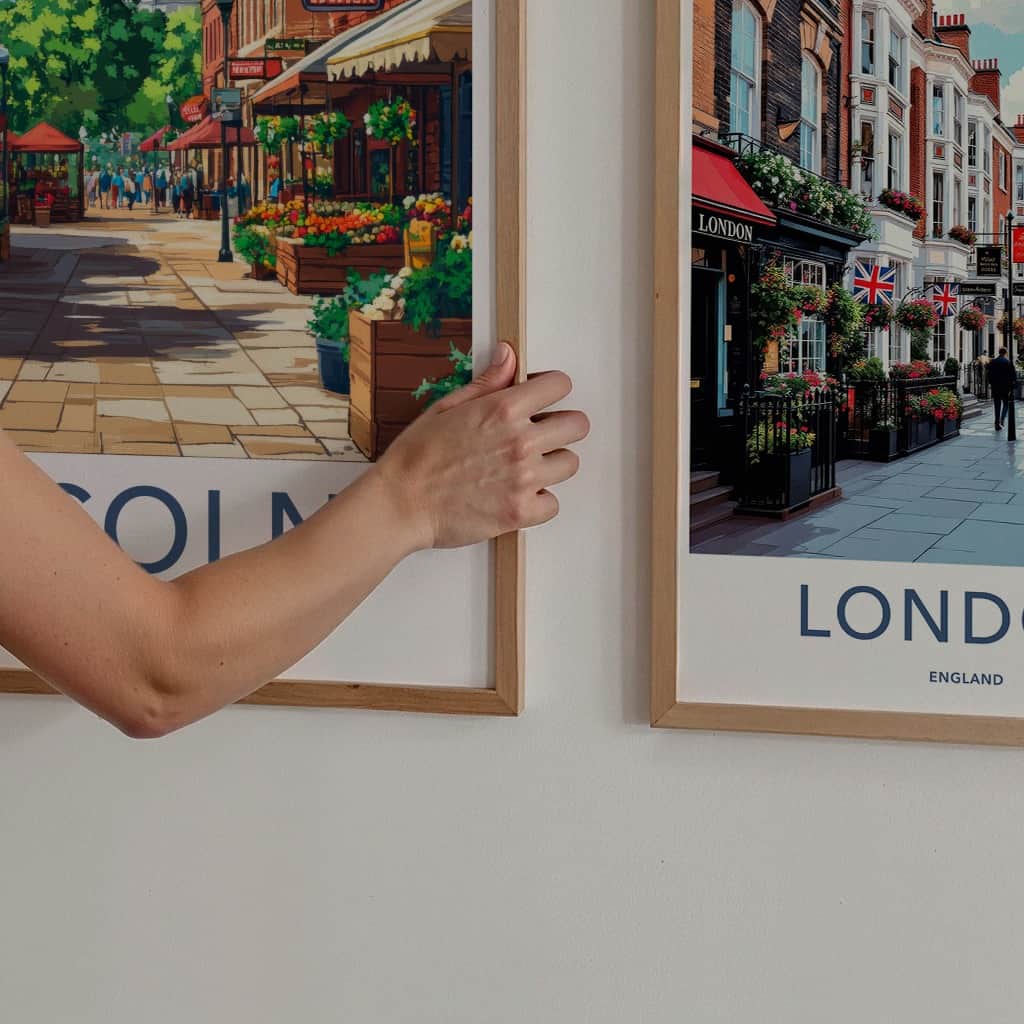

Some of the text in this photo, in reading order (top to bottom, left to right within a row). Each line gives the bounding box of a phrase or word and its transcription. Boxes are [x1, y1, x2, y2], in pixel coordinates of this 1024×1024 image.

[699, 214, 753, 241] LONDON
[800, 584, 1024, 645] LOND
[928, 670, 1004, 686] ENGLAND
